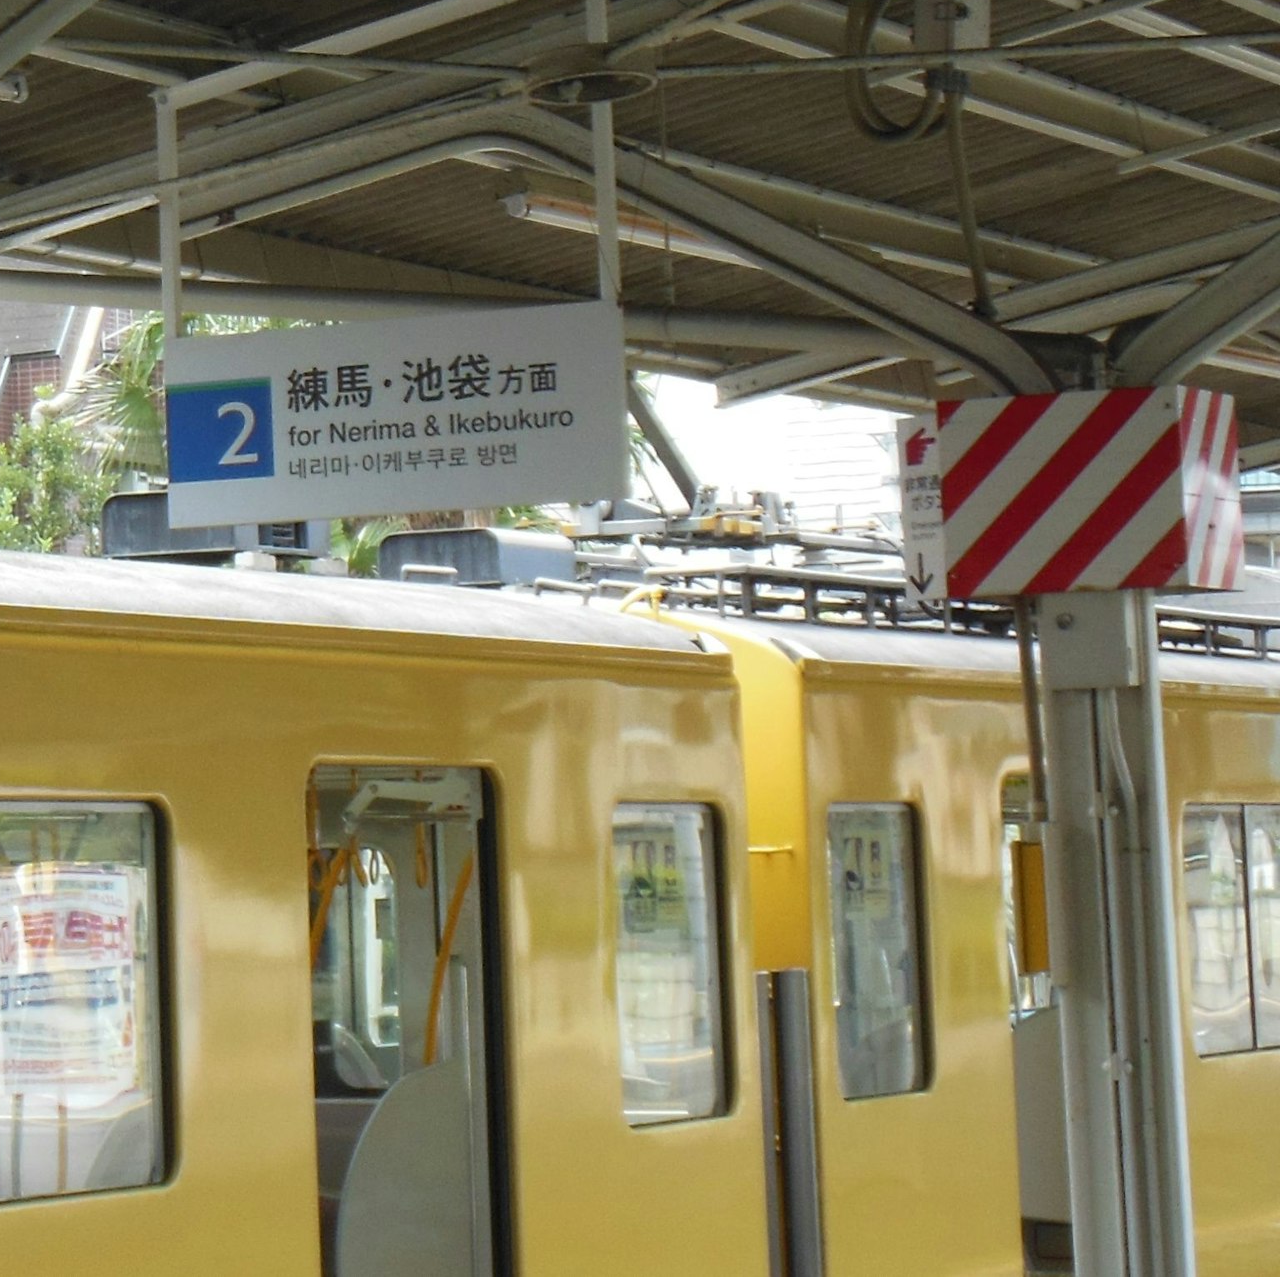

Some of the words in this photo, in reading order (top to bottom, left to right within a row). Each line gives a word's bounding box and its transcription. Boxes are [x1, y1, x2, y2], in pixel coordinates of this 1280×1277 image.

[217, 402, 259, 466] 2
[288, 425, 321, 447] for
[329, 419, 417, 445] Nerima
[424, 416, 441, 438] &
[449, 406, 575, 435] Ikebukuro
[477, 442, 519, 466] 방면
